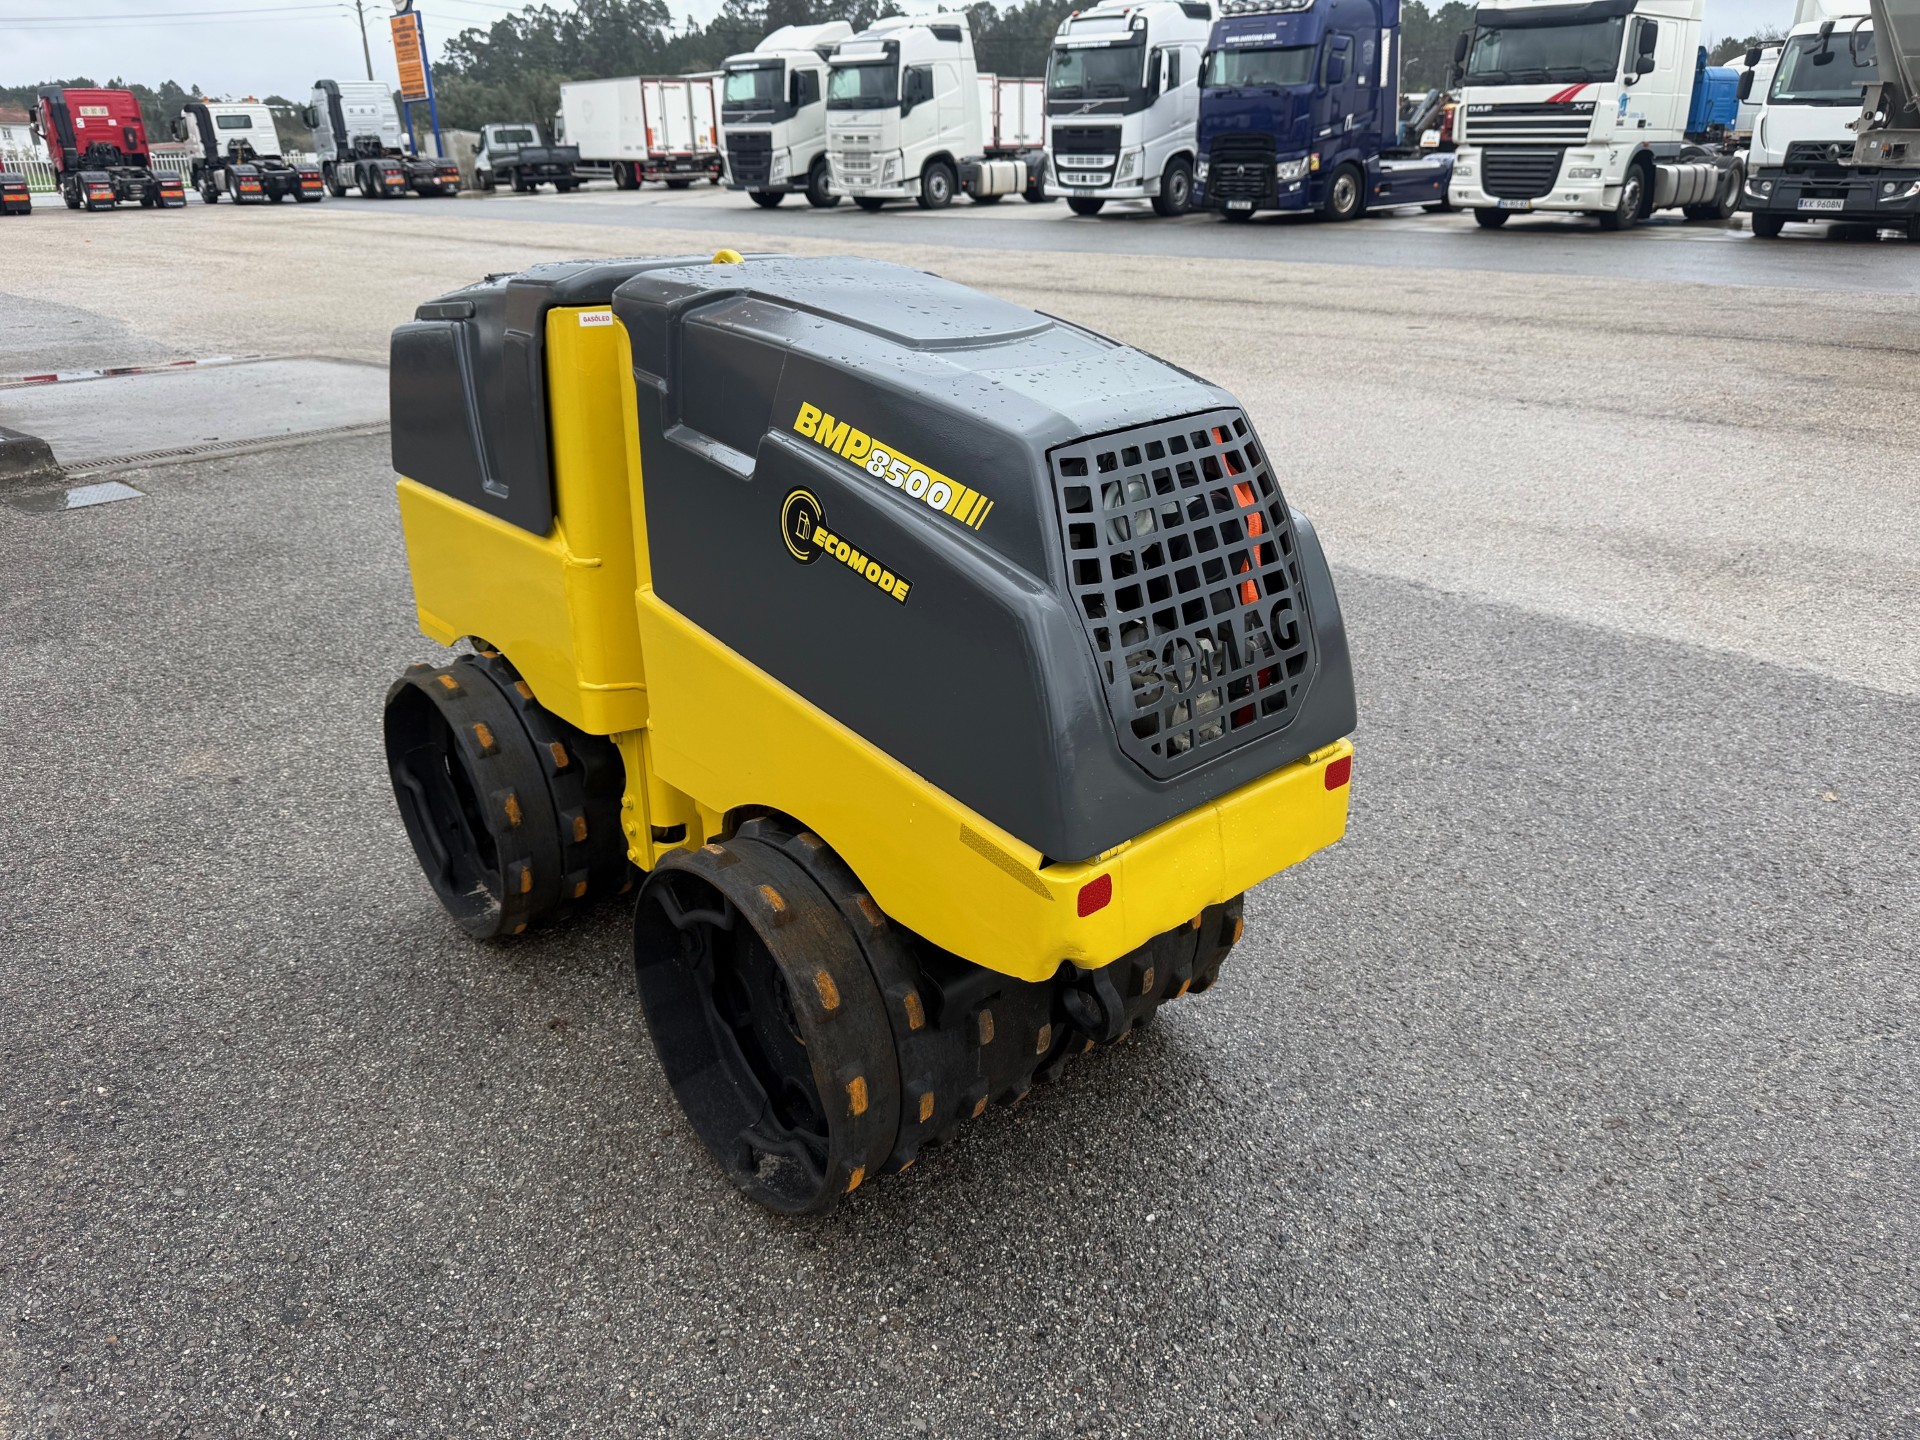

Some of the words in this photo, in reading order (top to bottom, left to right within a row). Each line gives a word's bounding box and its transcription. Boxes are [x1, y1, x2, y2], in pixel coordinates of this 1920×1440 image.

[1468, 104, 1493, 112] DAF
[1572, 103, 1594, 111] XF
[1803, 200, 1814, 208] KK
[812, 526, 911, 602] ECOMODE
[1125, 597, 1301, 709] BOMAG
